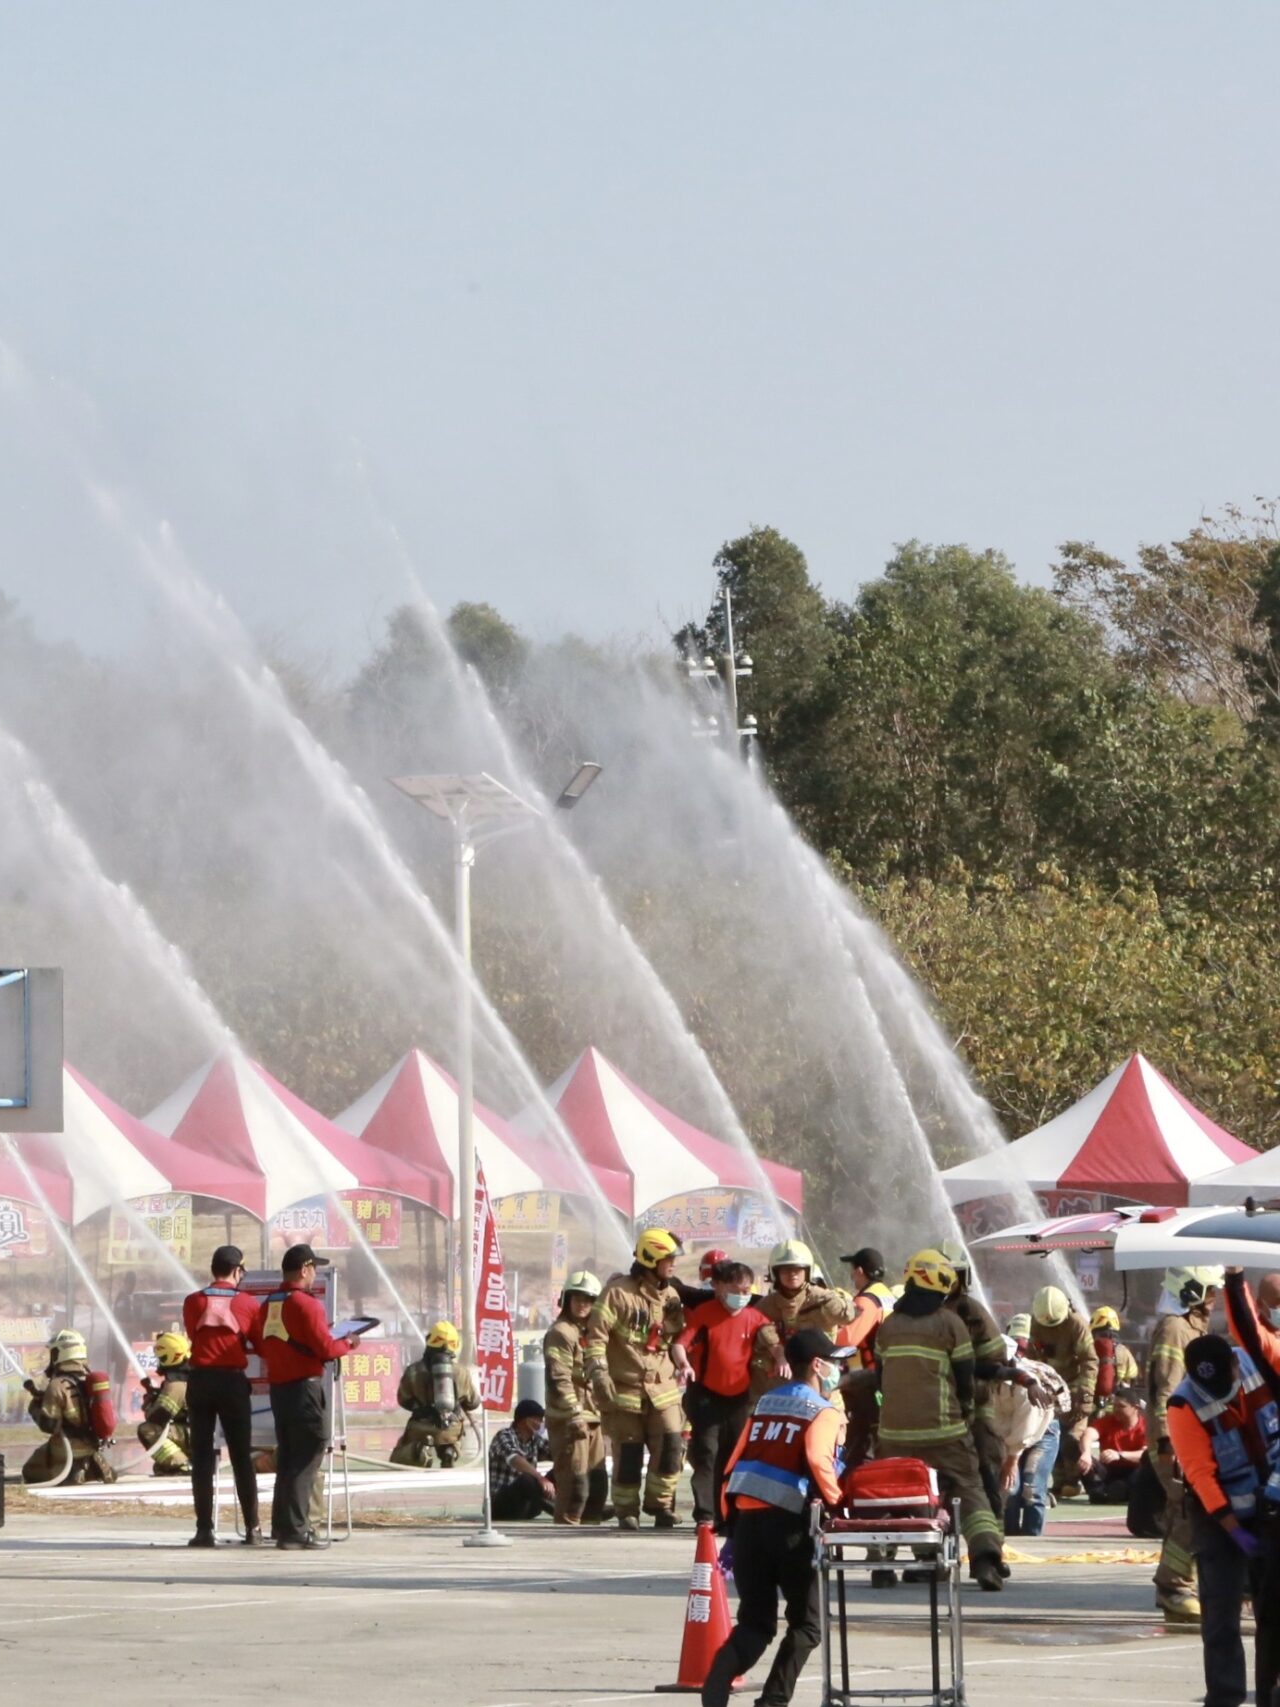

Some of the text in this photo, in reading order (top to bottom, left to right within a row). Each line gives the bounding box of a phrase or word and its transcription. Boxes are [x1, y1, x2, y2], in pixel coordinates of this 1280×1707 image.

[344, 1380, 381, 1403] 香腸
[749, 1421, 801, 1444] EMT
[687, 1562, 714, 1623] 重傷
